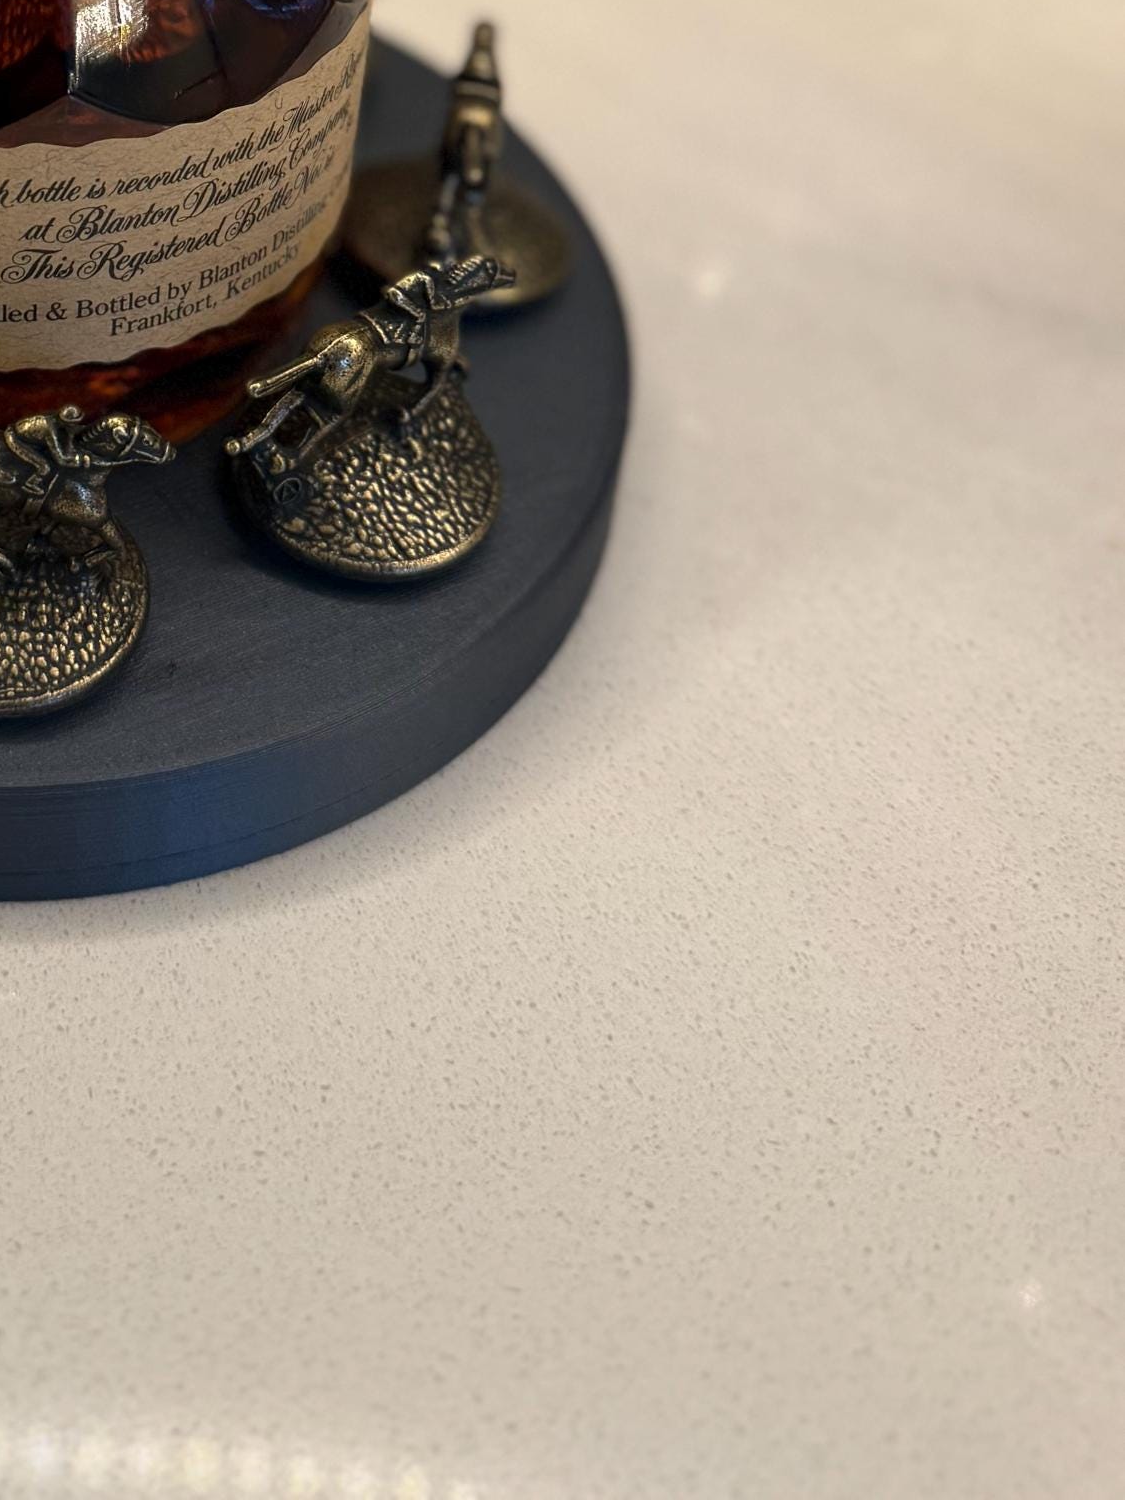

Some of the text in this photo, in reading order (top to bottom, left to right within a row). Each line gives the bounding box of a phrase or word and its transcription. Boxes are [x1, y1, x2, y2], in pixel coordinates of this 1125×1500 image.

[11, 177, 81, 204] bottle
[83, 178, 107, 200] is
[107, 148, 213, 197] recorded
[212, 131, 259, 172] with
[256, 121, 287, 152] the
[18, 217, 57, 243] at
[56, 203, 181, 244] Blanton
[177, 156, 288, 224] Distilling
[0, 248, 75, 285] This
[76, 215, 225, 283] Registered
[225, 181, 293, 242] Bottle
[46, 301, 68, 322] &
[75, 286, 161, 319] Bottled
[167, 280, 194, 303] by
[198, 245, 268, 291] Blanton
[109, 241, 300, 337] Frankfort, Kentucky
